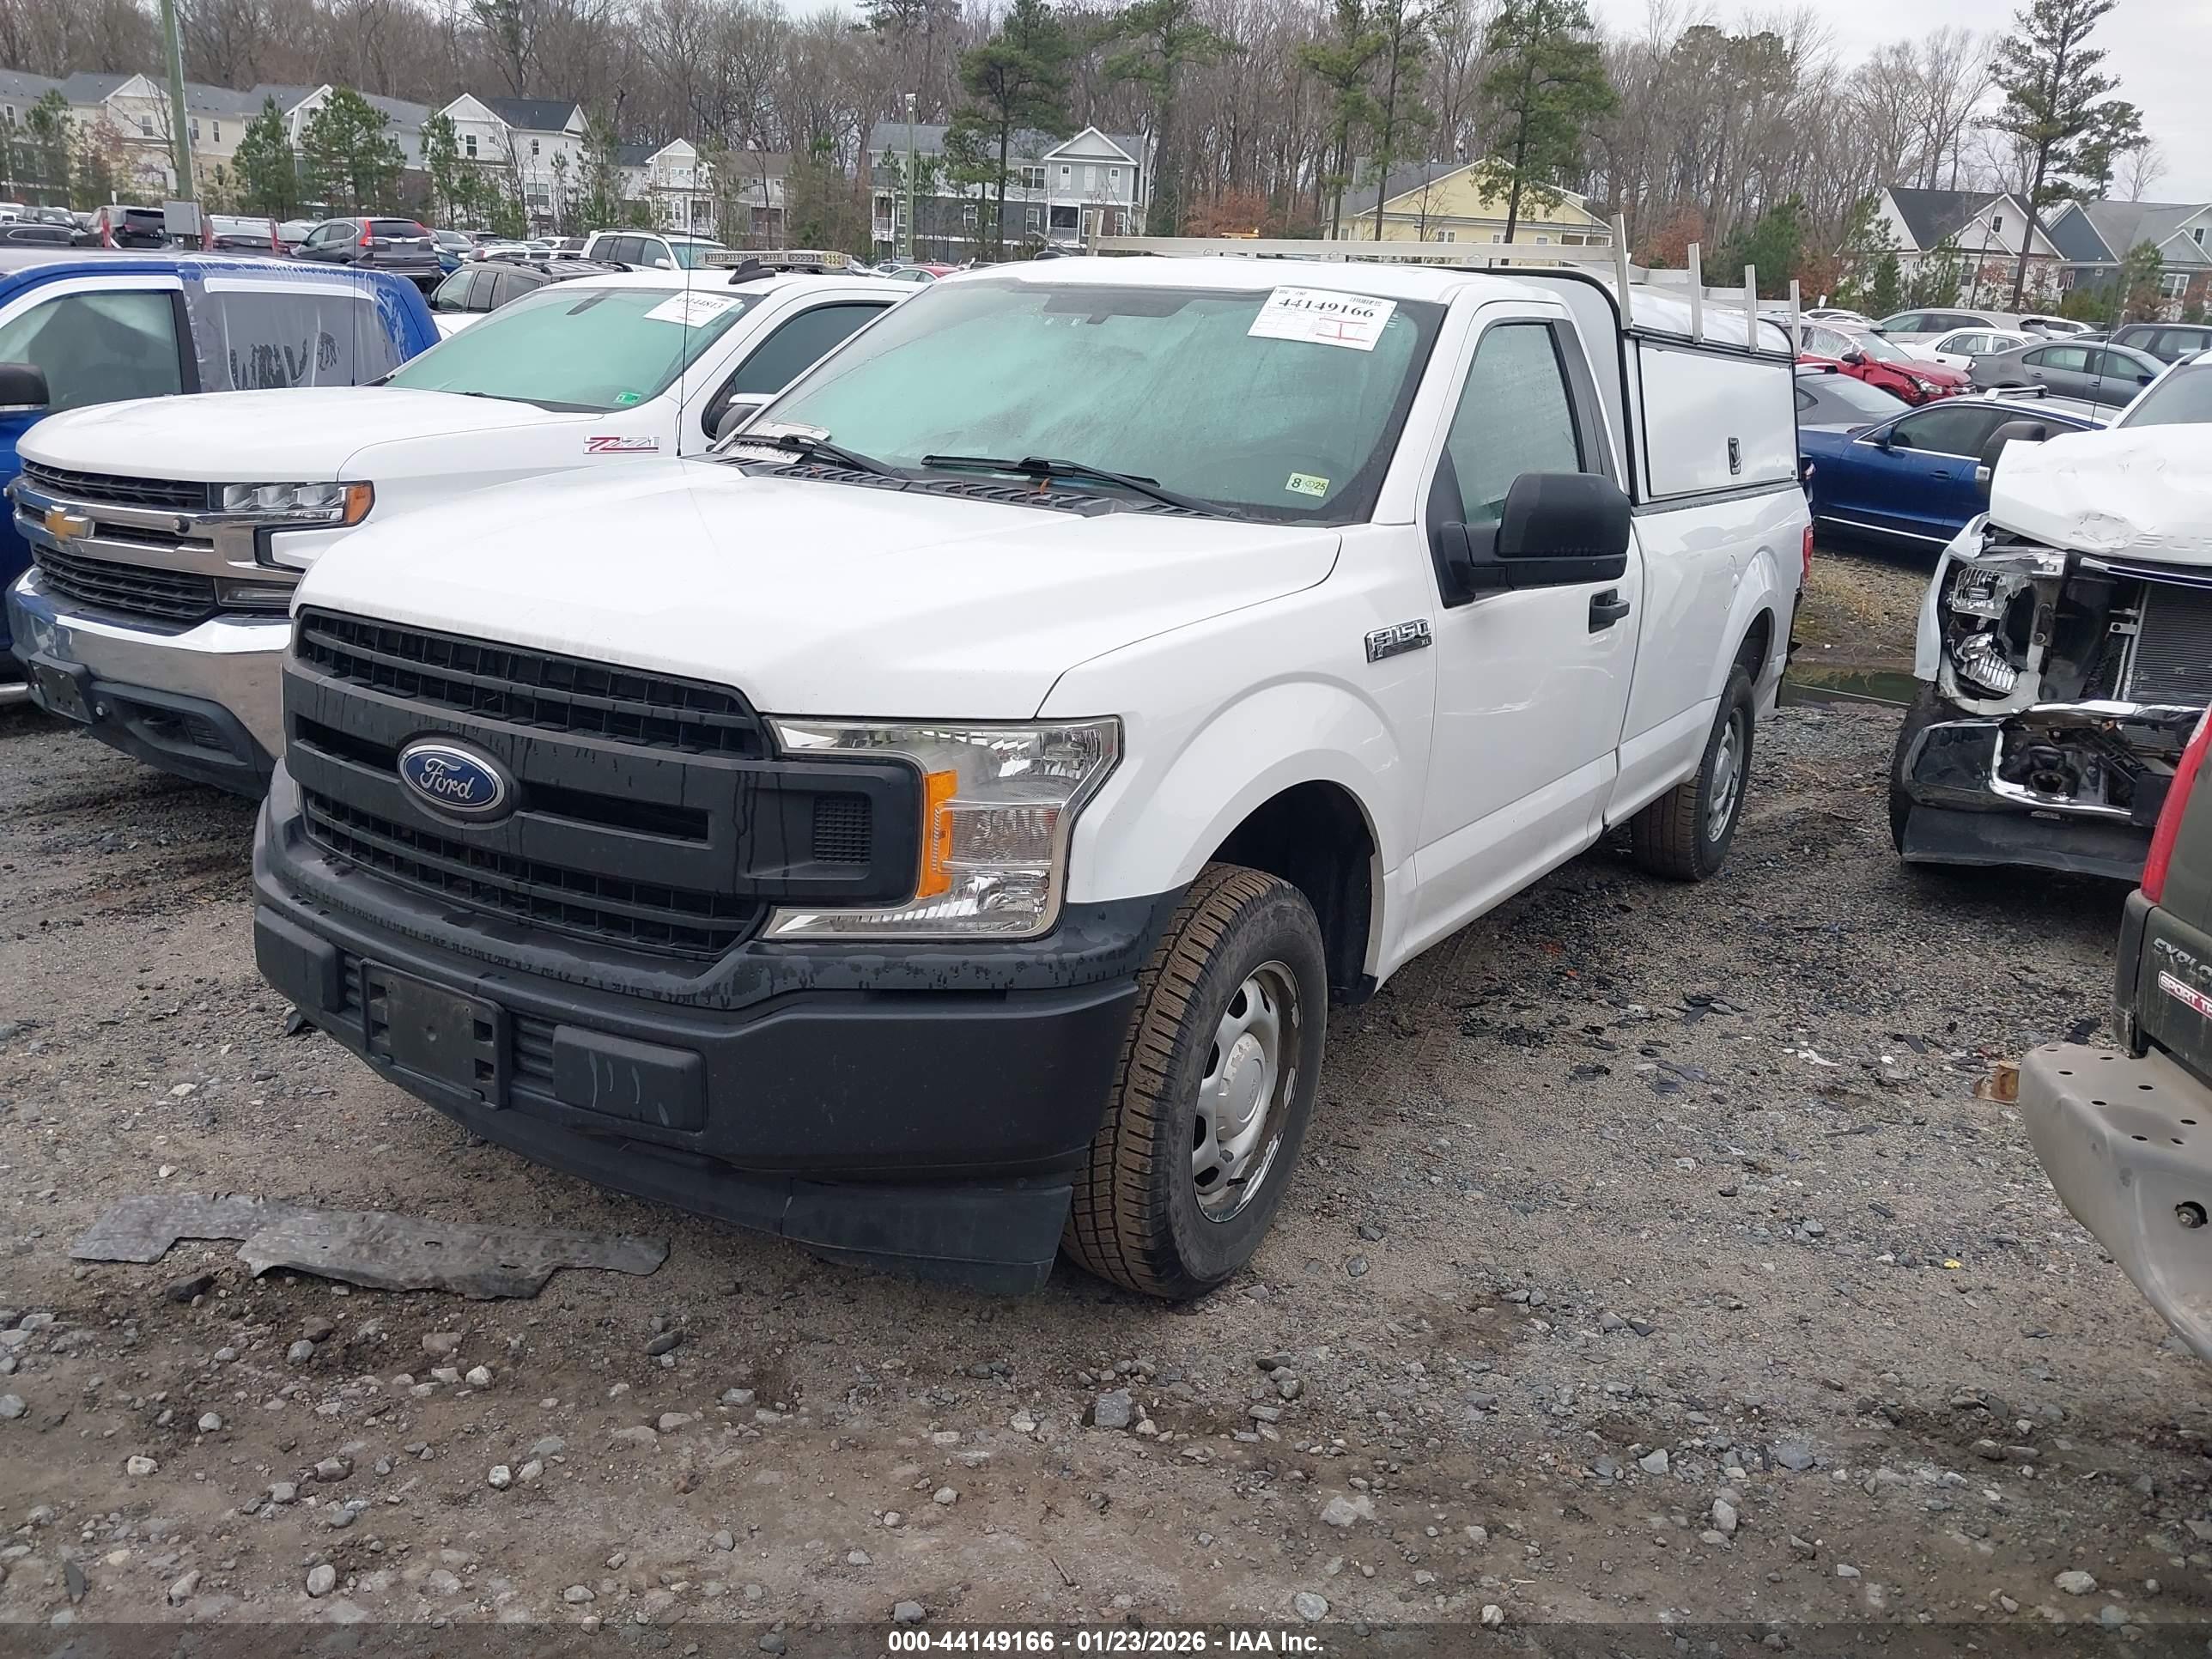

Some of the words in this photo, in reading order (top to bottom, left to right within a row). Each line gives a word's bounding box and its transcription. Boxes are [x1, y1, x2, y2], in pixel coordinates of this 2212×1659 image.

[1278, 298, 1376, 318] 44149166
[583, 435, 659, 454] Z71
[1291, 477, 1302, 489] 8
[1314, 481, 1327, 491] 25
[1421, 637, 1431, 647] XL
[419, 757, 476, 799] Ford
[2160, 975, 2199, 1006] SPORT
